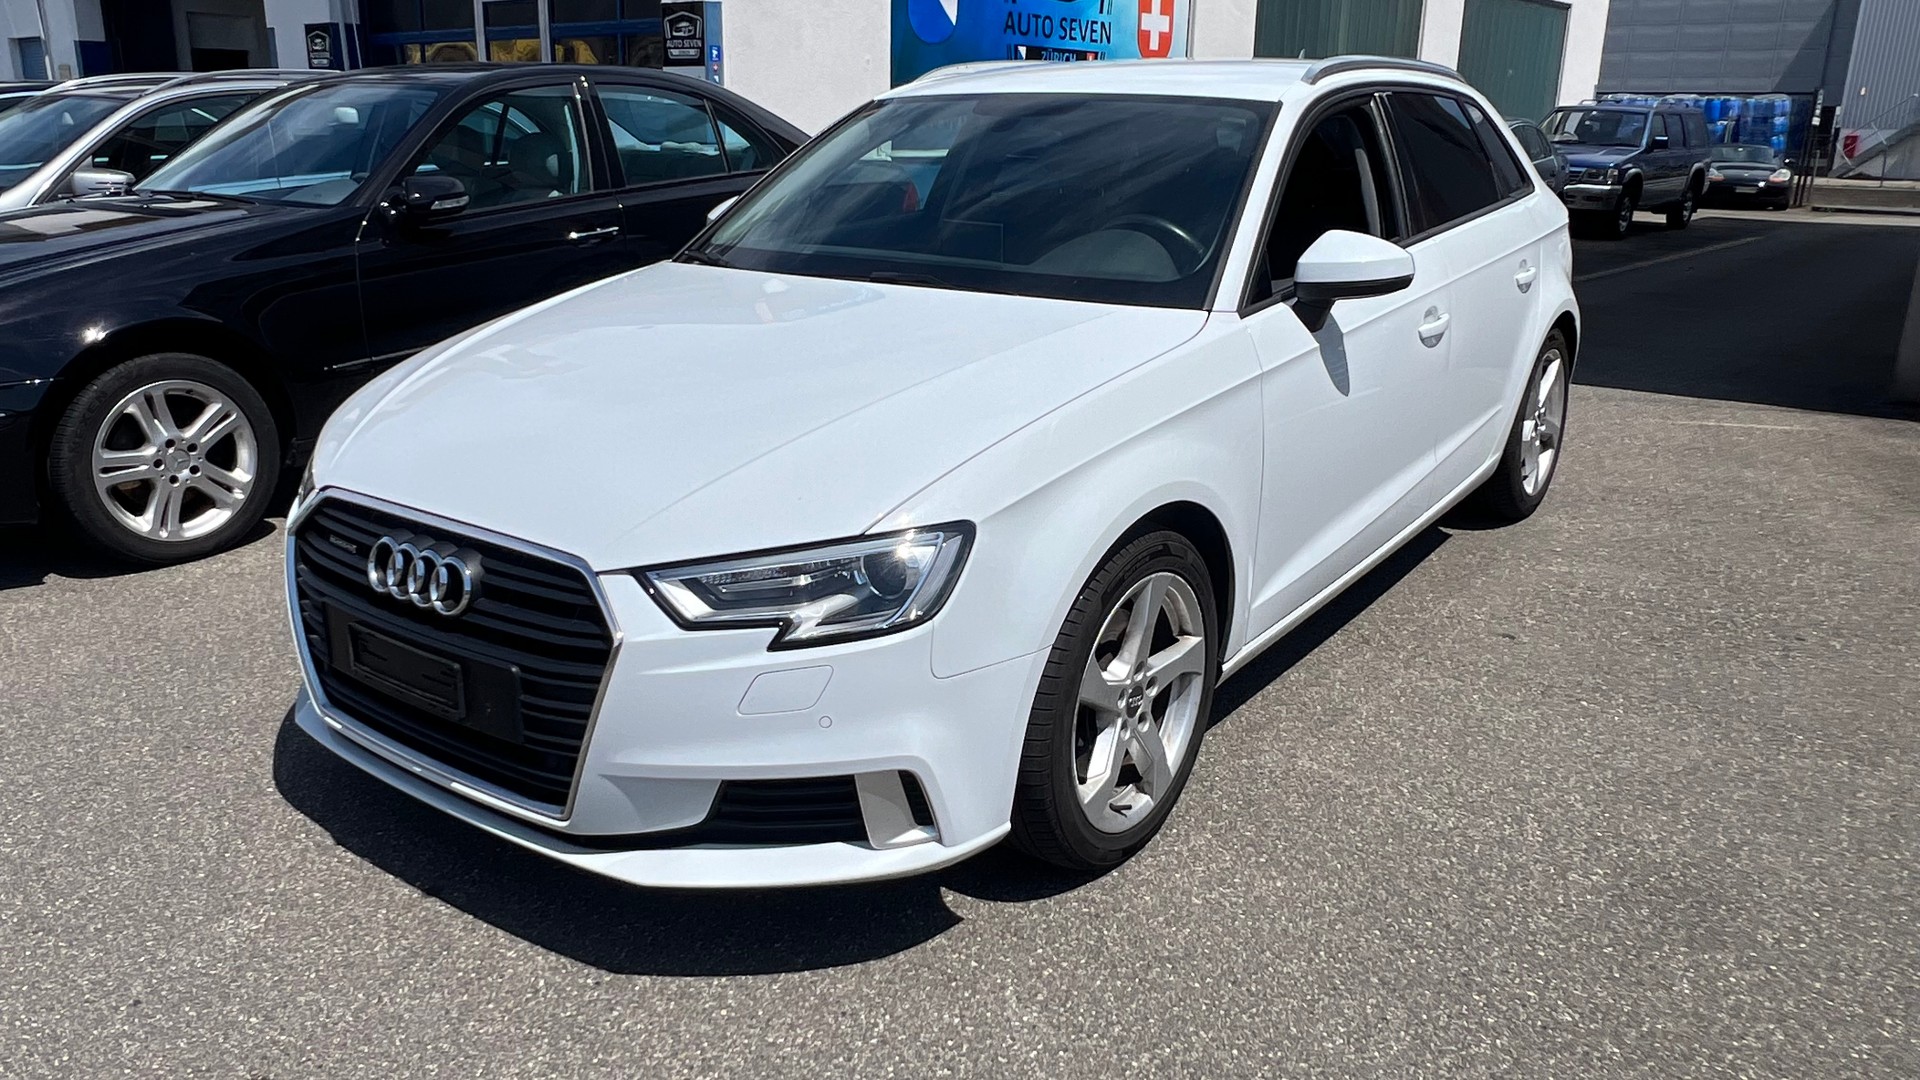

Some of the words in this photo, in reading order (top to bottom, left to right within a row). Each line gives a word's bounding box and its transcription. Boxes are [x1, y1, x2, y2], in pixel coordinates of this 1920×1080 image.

[1004, 11, 1054, 38] AUTO
[1059, 17, 1111, 44] SEVEN
[666, 39, 683, 48] AUTO
[683, 39, 702, 48] SEVEN
[1041, 49, 1077, 62] ZÜRICH
